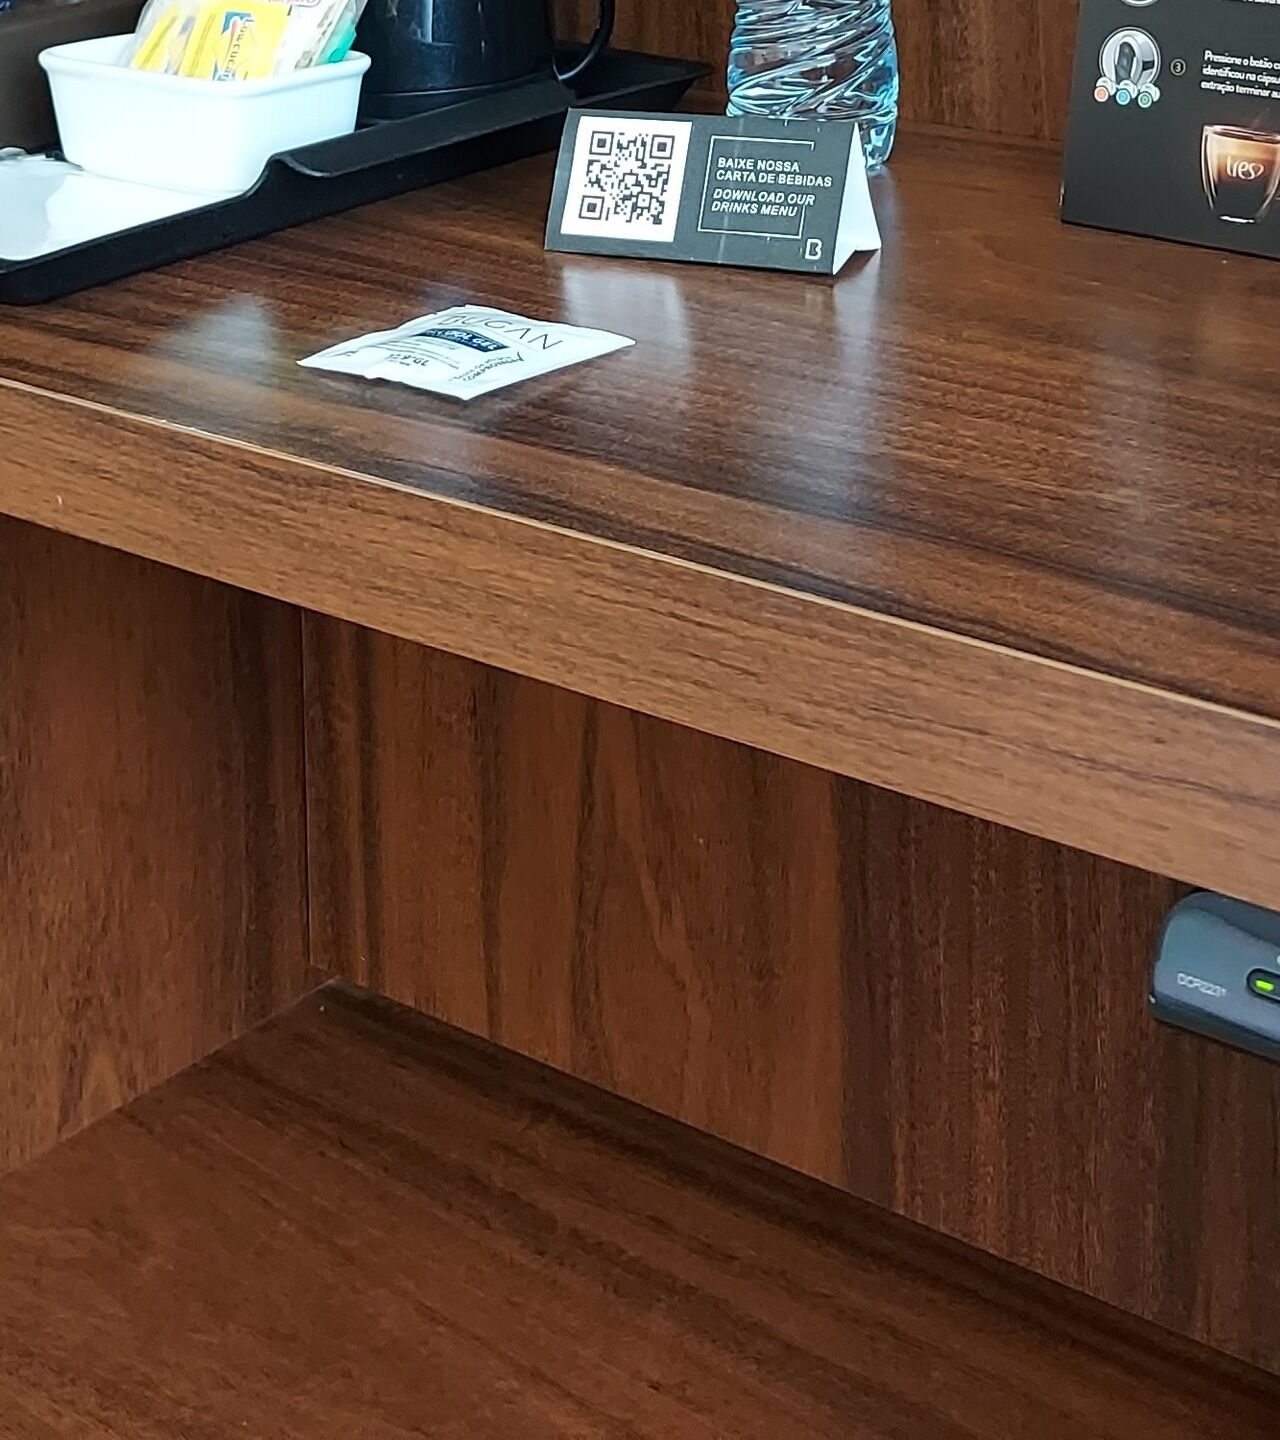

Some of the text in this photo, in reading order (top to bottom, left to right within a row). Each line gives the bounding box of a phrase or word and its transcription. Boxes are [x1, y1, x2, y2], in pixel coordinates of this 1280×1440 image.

[1202, 64, 1245, 79] identificou
[1245, 72, 1256, 81] na
[717, 157, 800, 172] BAIXE NOSSA
[716, 170, 833, 187] CARTA DE BEBIDAS
[713, 188, 816, 206] DOWNLOAD OUR
[711, 201, 798, 217] DRINKS MENU
